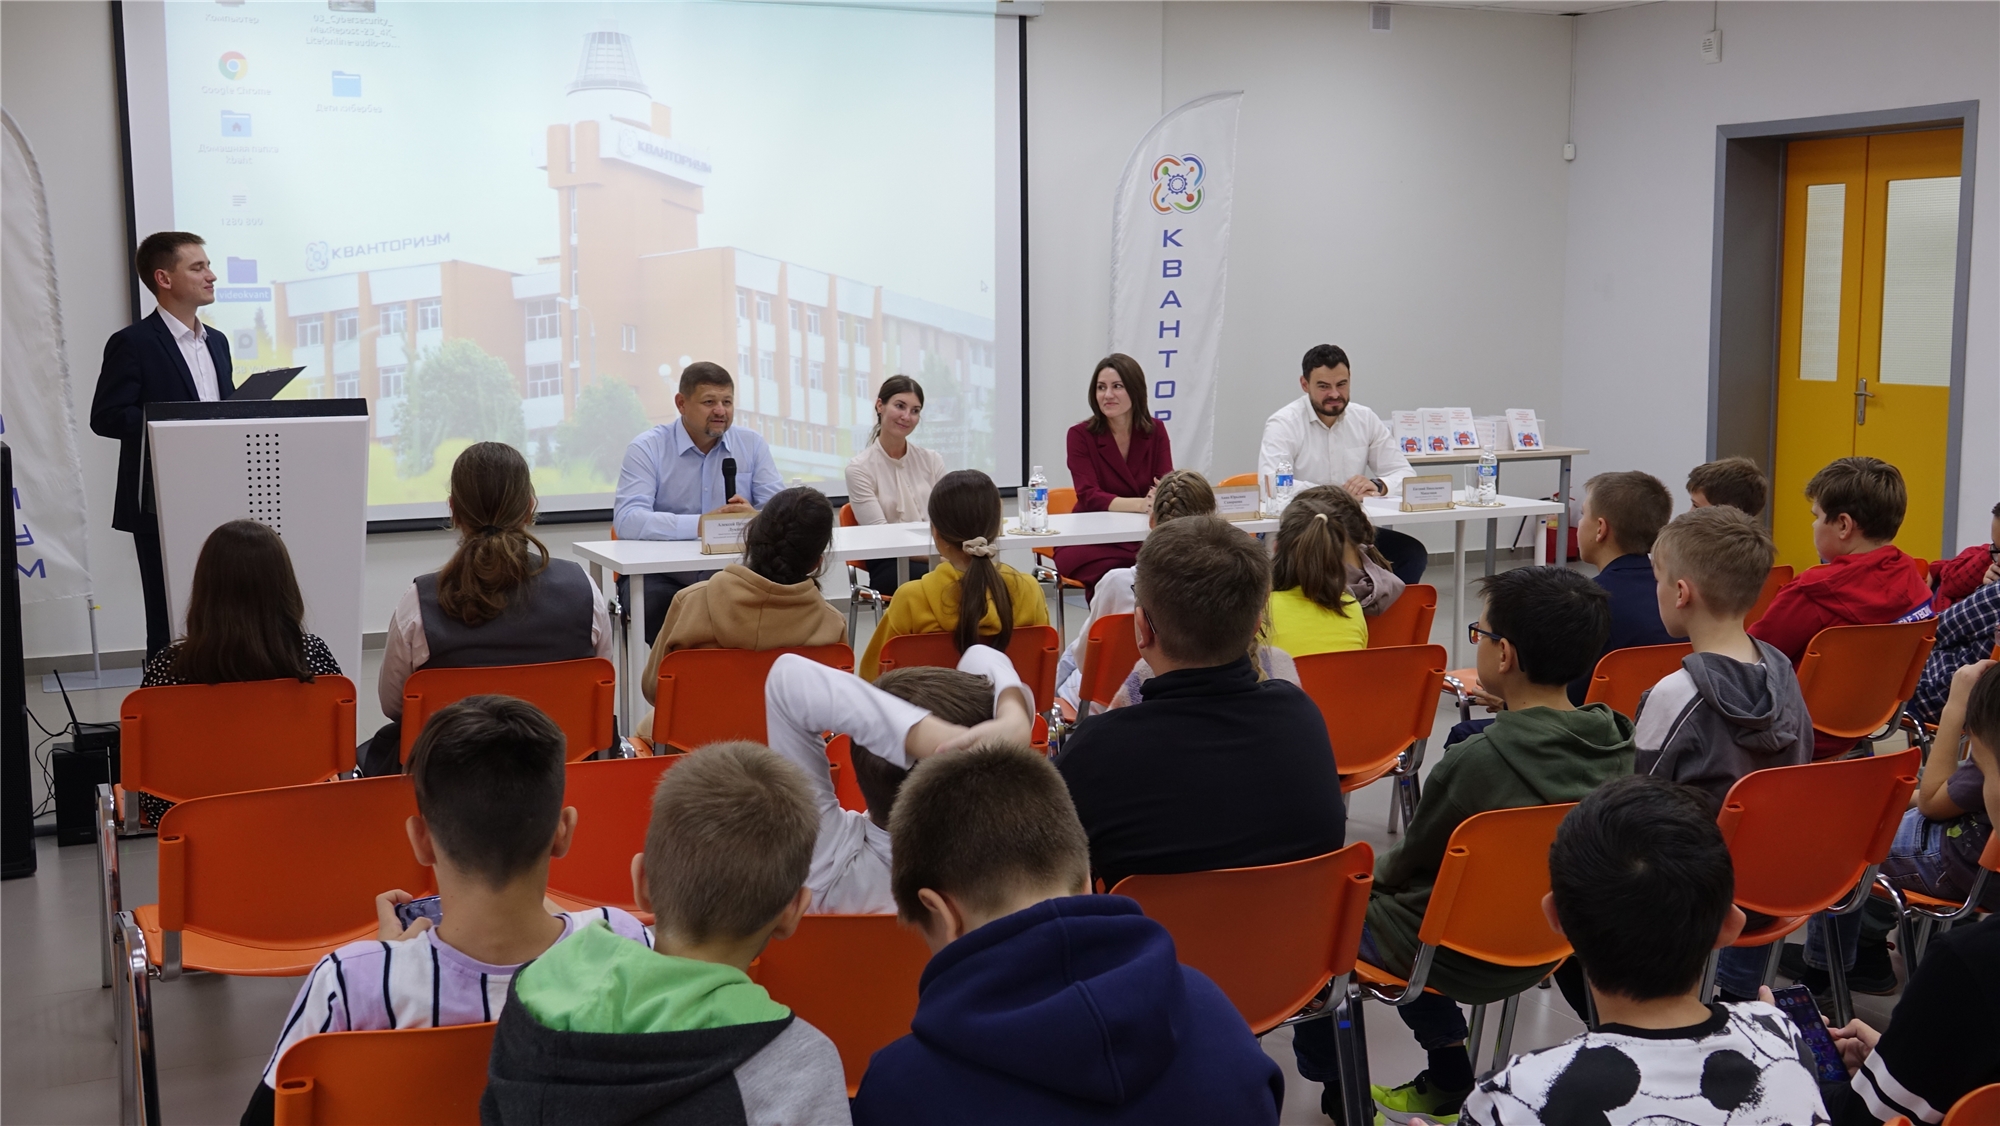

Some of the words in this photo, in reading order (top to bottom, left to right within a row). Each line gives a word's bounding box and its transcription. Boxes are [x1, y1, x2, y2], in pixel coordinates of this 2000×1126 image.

[205, 13, 260, 25] Компьютер
[201, 85, 234, 95] Google
[236, 86, 271, 95] Chrome
[315, 104, 338, 113] Дети
[198, 144, 250, 154] Домашняя
[251, 146, 279, 154] папка
[638, 140, 713, 173] КВАНТОРИУМ
[331, 233, 451, 260] КВАНТОРИУМ
[219, 290, 269, 300] videokvant
